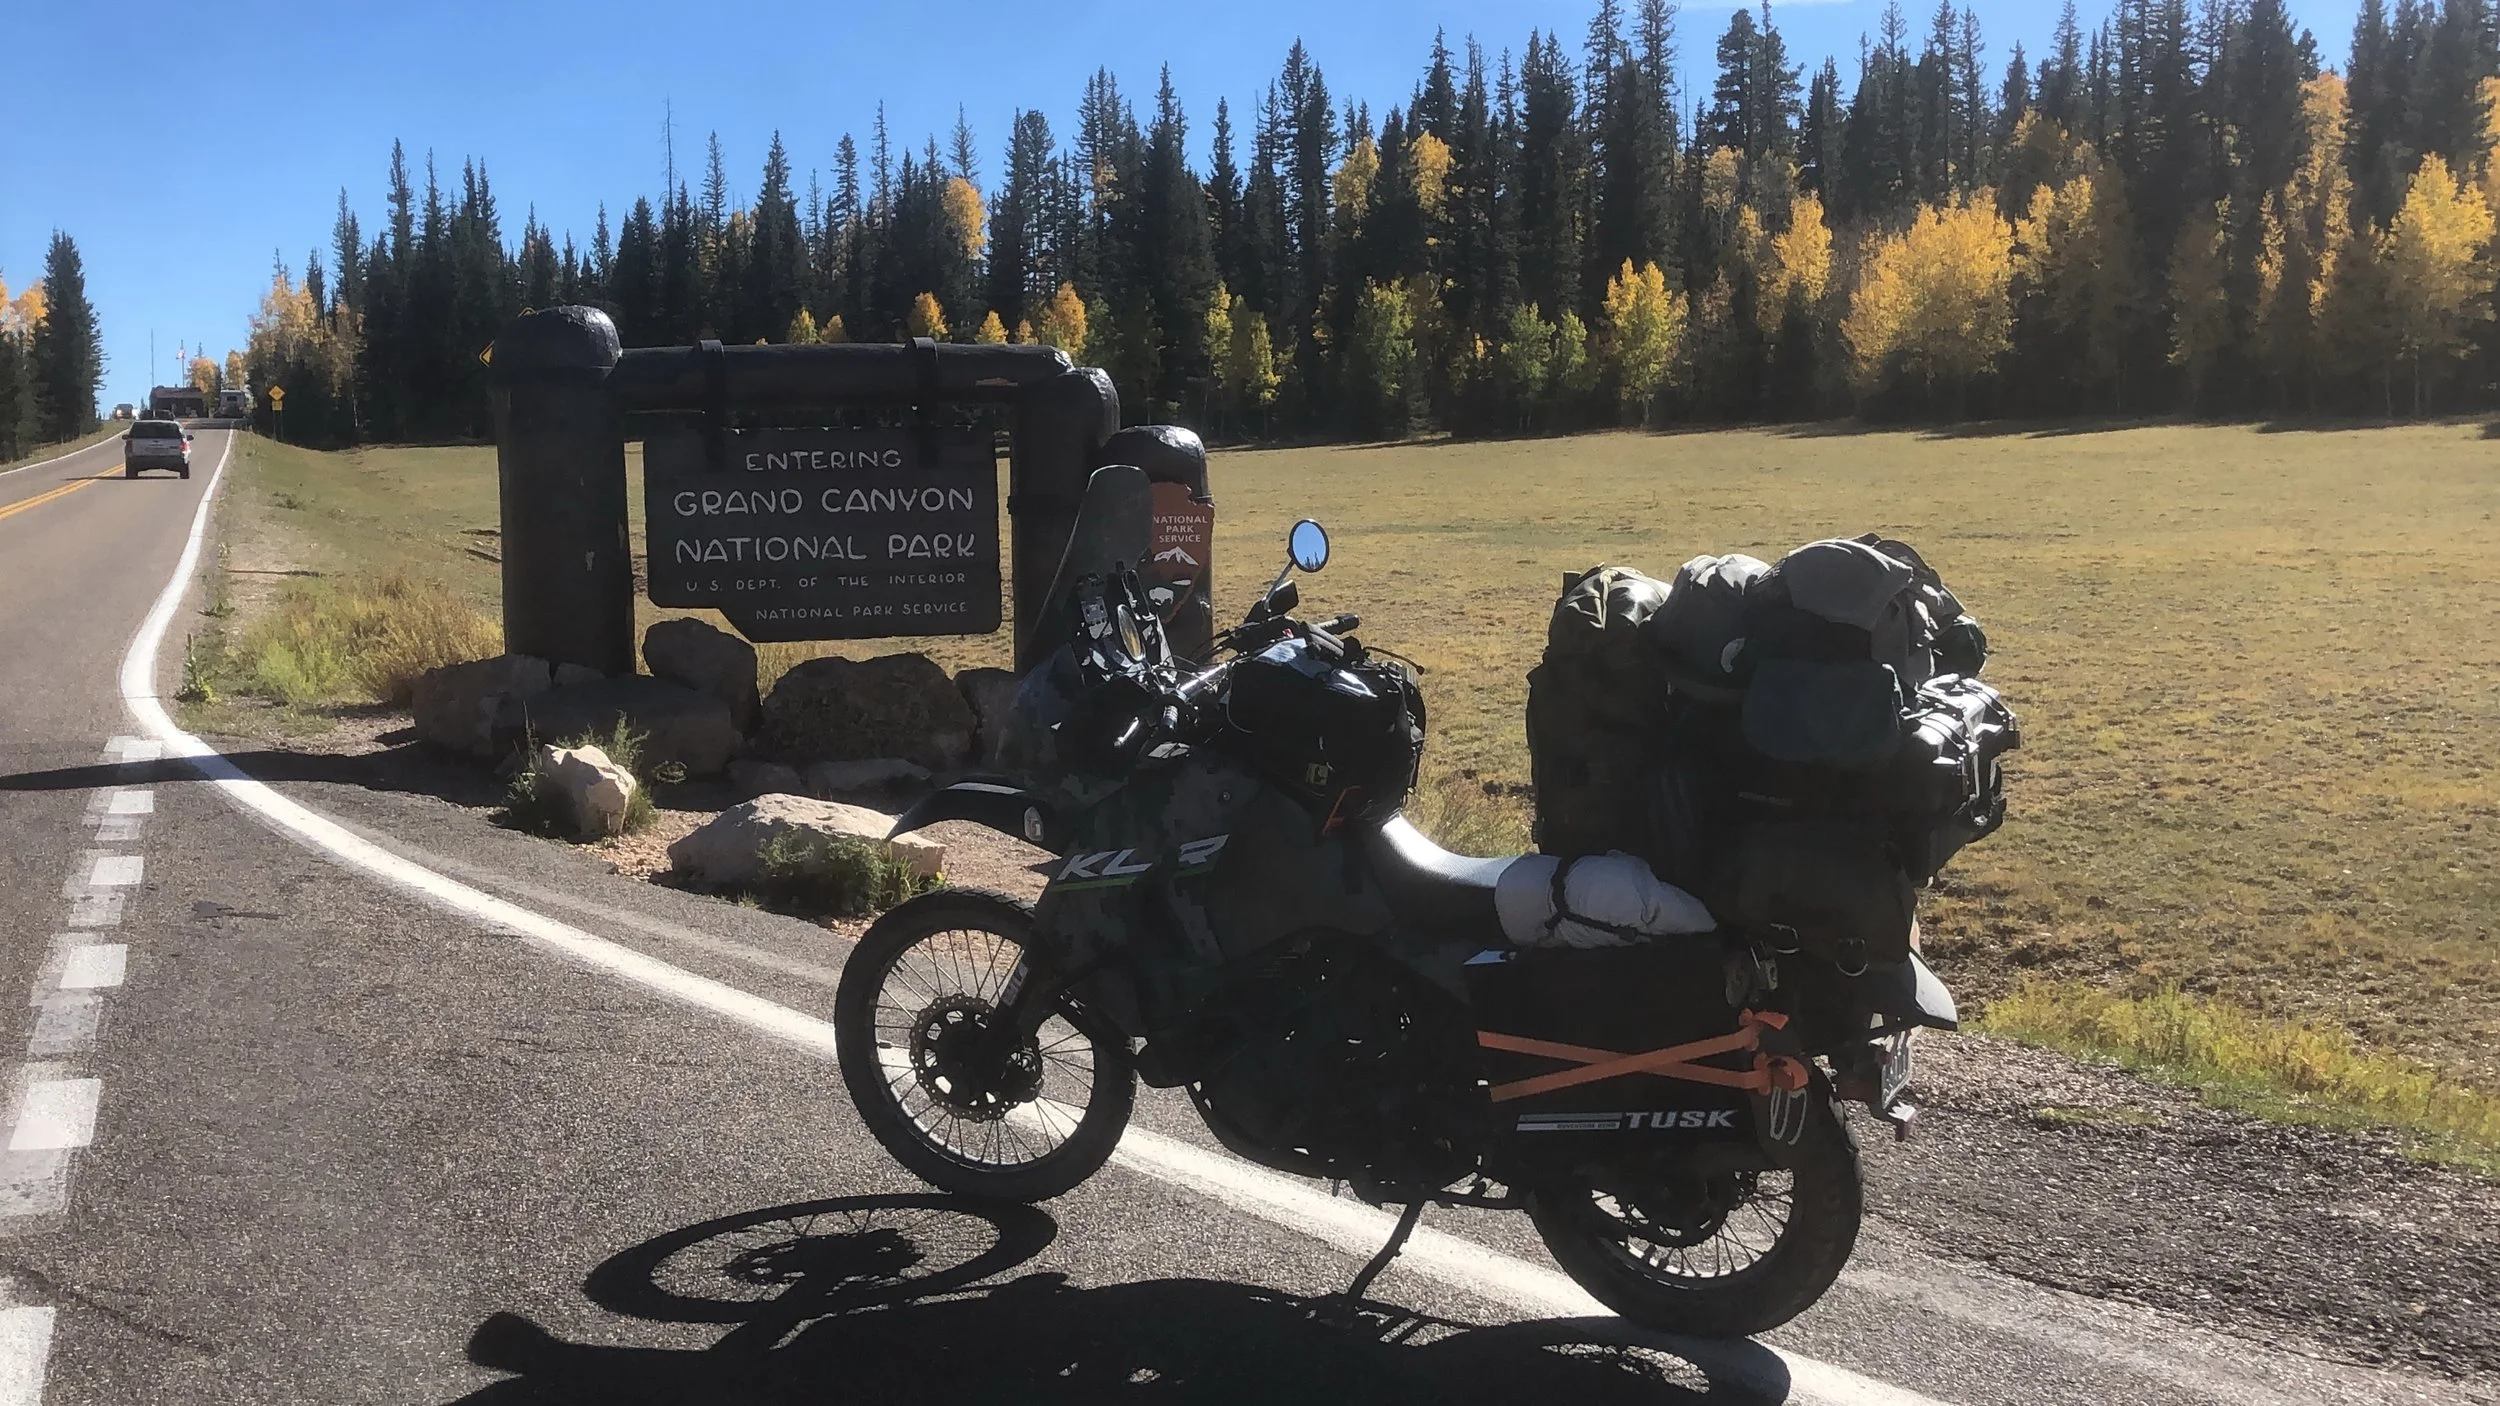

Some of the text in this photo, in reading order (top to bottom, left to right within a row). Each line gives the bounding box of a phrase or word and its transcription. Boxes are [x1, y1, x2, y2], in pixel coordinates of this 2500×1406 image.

[746, 450, 901, 471] ENTERING
[673, 487, 974, 516] GRAND CANYON
[1154, 516, 1207, 524] NATIONAL
[1166, 525, 1193, 533] PARK
[675, 533, 976, 564] NATIONAL PARK
[1159, 535, 1201, 543] SERVICE
[736, 578, 781, 591] DEPT.
[798, 577, 819, 588] OF
[837, 575, 869, 587] THE
[889, 572, 966, 585] INTERIOR
[756, 601, 968, 620] NATIONAL PARK SERVICE
[1625, 1110, 1738, 1128] TUSK
